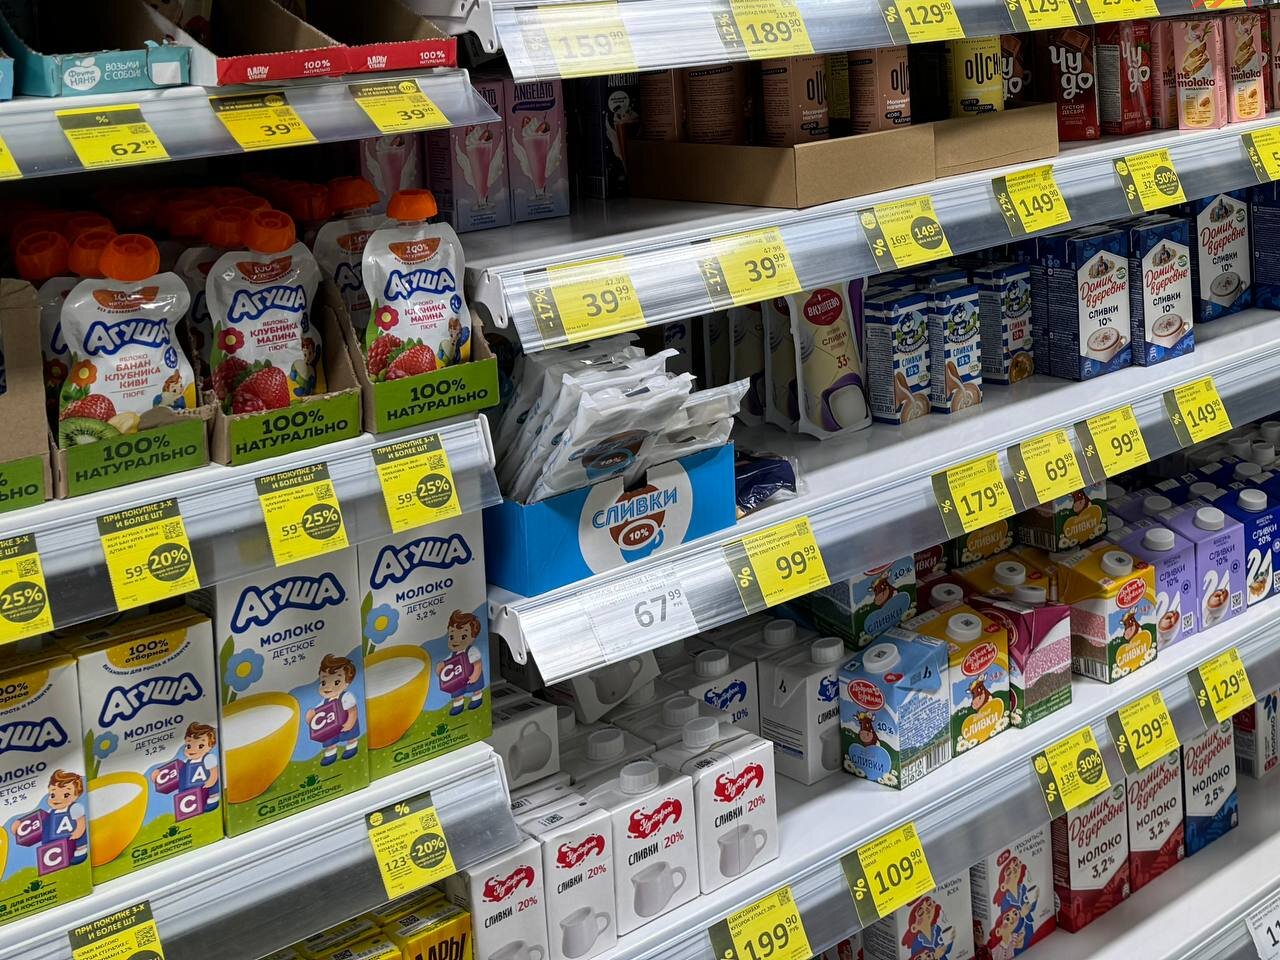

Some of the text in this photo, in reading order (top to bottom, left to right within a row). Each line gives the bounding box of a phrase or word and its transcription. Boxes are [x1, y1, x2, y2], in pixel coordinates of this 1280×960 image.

[904, 4, 944, 27] 129
[746, 21, 793, 45] 189
[556, 34, 612, 60] 159
[104, 59, 140, 71] ВОЗЬМИ
[1176, 74, 1216, 87] moloko
[397, 106, 424, 121] 39
[259, 122, 290, 137] 39
[110, 142, 142, 157] 62
[1018, 193, 1054, 218] 149
[914, 225, 935, 239] 149
[745, 255, 778, 282] 39
[1144, 262, 1175, 288] Домик
[1080, 273, 1114, 302] Домик
[581, 287, 619, 318] 39
[807, 296, 840, 317] ВКУШЕЕВО
[250, 322, 298, 338] КЛУБНИКА
[410, 312, 444, 324] МАЛИНА
[257, 331, 297, 345] МАЛИНА
[104, 366, 161, 382] КЛУБНИКА
[116, 359, 151, 373] БАНАН
[119, 377, 149, 390] КИВИ
[409, 377, 466, 403] 100%
[386, 387, 488, 421] НАТУРАЛЬНО
[1186, 403, 1217, 429] 149
[260, 407, 325, 435] 100%
[102, 434, 171, 463] 100%
[236, 418, 349, 455] НАТУРАЛЬНО
[1110, 432, 1133, 457] 99
[75, 443, 198, 484] НАТУРАЛЬНО
[1043, 455, 1068, 483] 69
[418, 477, 450, 497] 25%
[122, 503, 158, 519] ПОКУПКЕ
[591, 486, 679, 530] СЛИВКИ
[959, 486, 999, 517] 179
[123, 514, 150, 526] БОЛЕЕ
[303, 508, 339, 528] 25%
[627, 527, 650, 541] 10%
[150, 549, 188, 569] 20%
[371, 535, 472, 589] АГУША
[1208, 543, 1236, 560] СЛИВКИ
[776, 550, 808, 581] 99
[394, 575, 454, 603] МОЛОКО
[232, 574, 345, 631] АГУША
[405, 594, 447, 616] ДЕТСКОЕ
[634, 594, 672, 628] 67
[259, 618, 326, 647] МОЛОКО
[124, 647, 170, 664] отборное
[272, 638, 316, 661] ДЕТСКОЕ
[99, 673, 203, 727] АГУША
[1211, 679, 1240, 705] 129
[123, 713, 185, 740] МОЛОКО
[731, 707, 749, 723] 10%
[134, 731, 175, 751] ДЕТСКОЕ
[1130, 721, 1164, 751] 299
[1077, 754, 1101, 774] -30%
[1191, 763, 1231, 795] МОЛОКО
[714, 794, 766, 829] СЛИВКИ 20%
[1135, 796, 1177, 830] МОЛОКО
[385, 837, 445, 873] 123 -20%
[628, 830, 685, 868] СЛИВКИ 20%
[1077, 831, 1122, 867] МОЛОКО
[557, 872, 583, 895] СЛИВКИ
[586, 863, 607, 881] 20%
[873, 857, 915, 896] 109
[1091, 854, 1116, 879] 3,2%
[74, 912, 130, 938] ПРИ ПОКУПКЕ
[484, 896, 538, 929] СЛИВКИ 20%
[744, 923, 790, 960] 199
